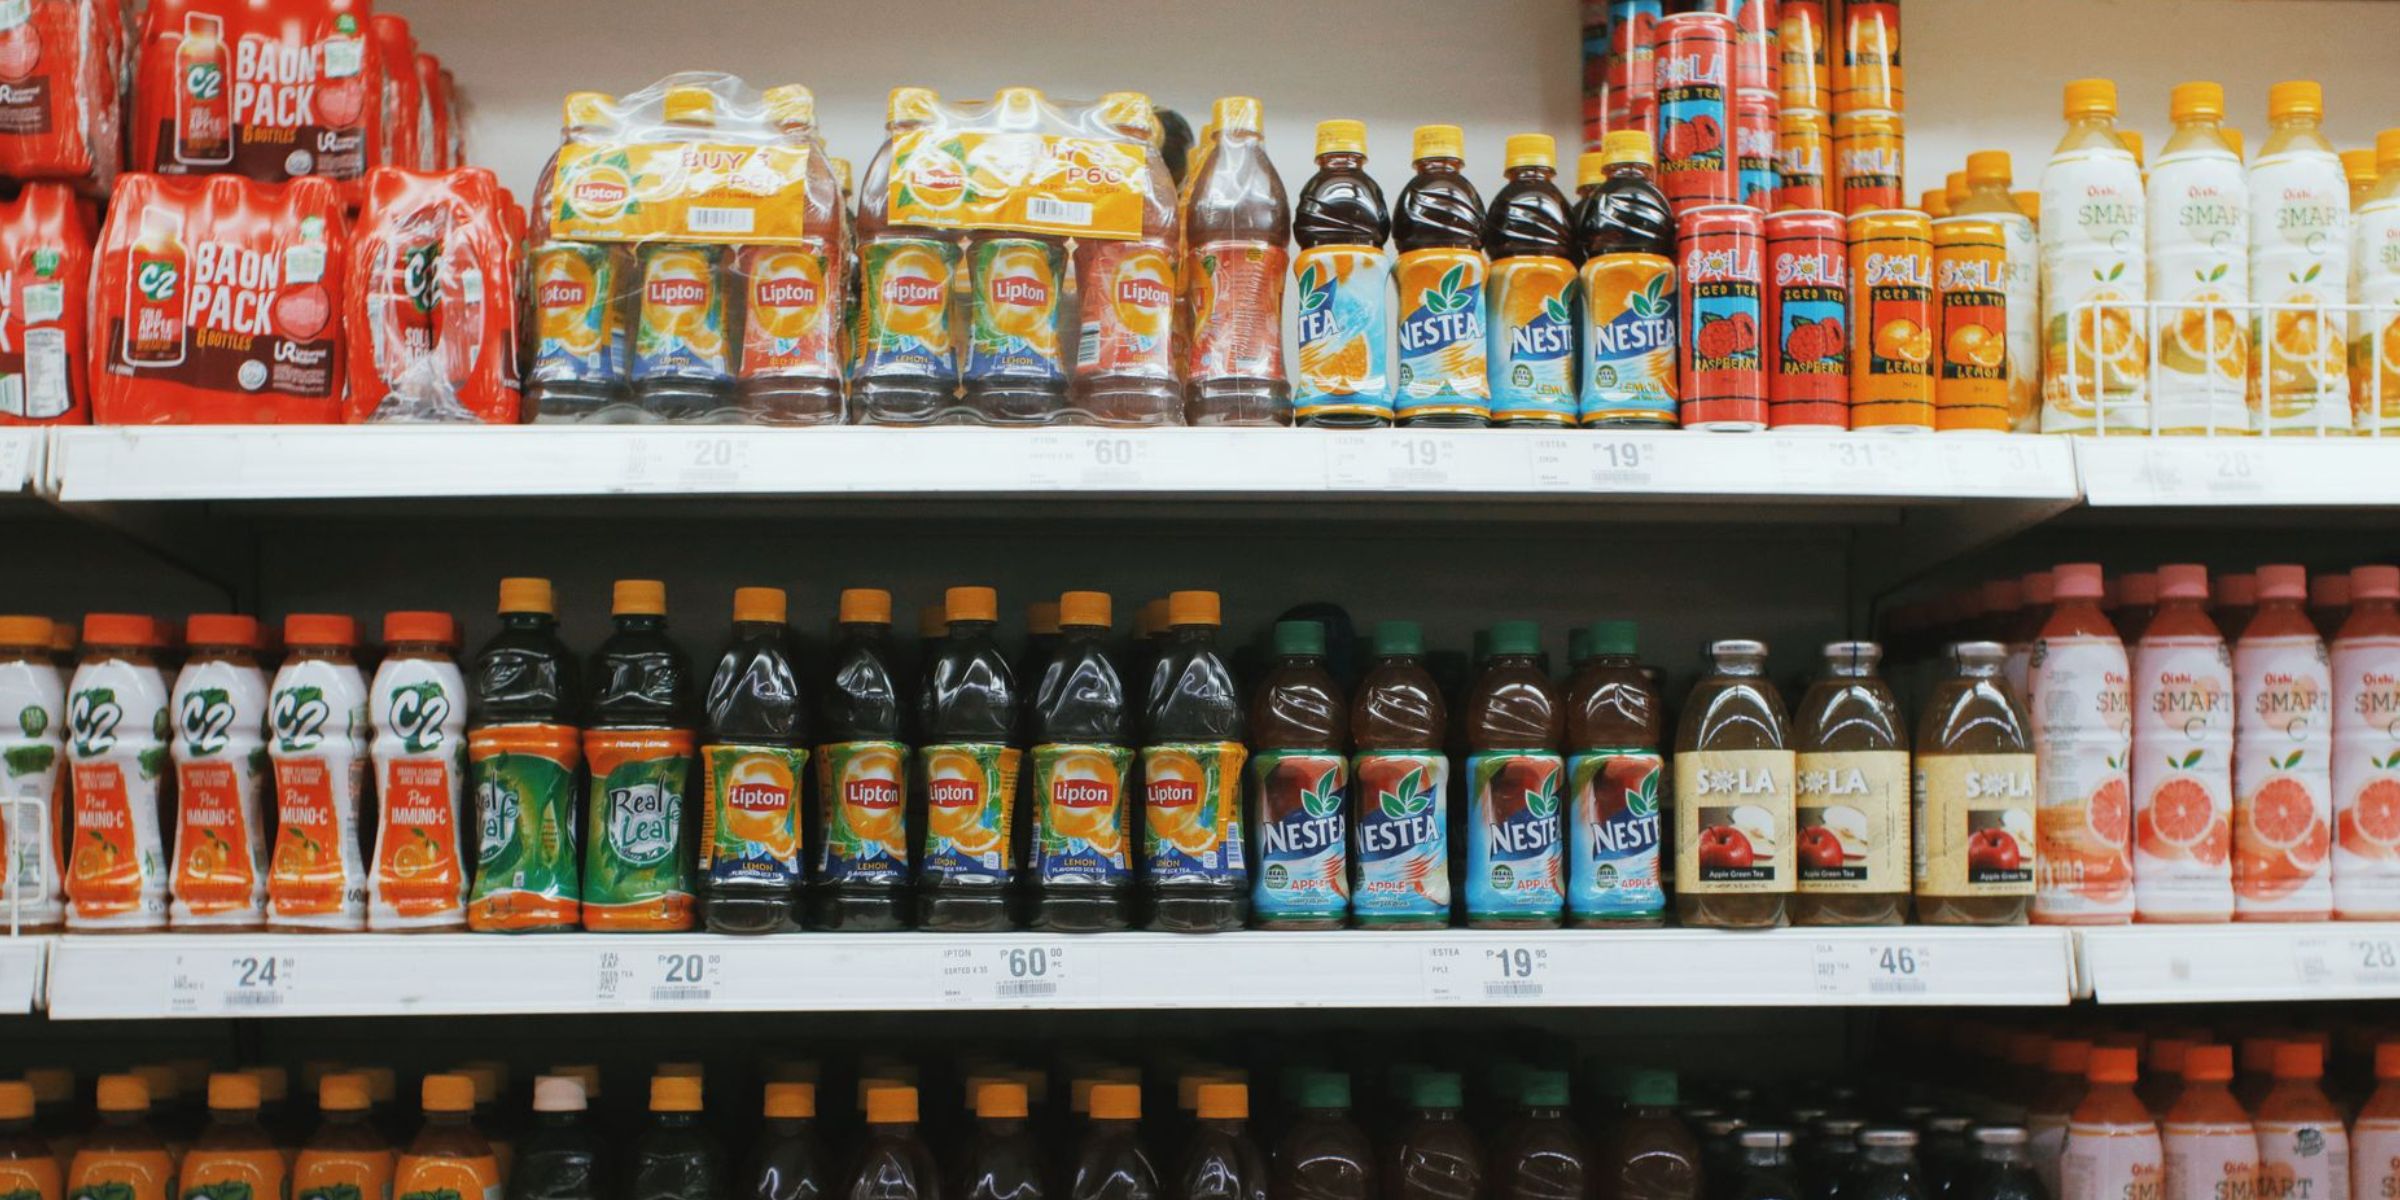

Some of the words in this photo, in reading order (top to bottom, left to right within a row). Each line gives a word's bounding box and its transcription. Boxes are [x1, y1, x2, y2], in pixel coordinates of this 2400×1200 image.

[236, 39, 318, 83] BAON
[187, 66, 222, 98] C2
[233, 82, 317, 128] PACK
[577, 186, 623, 202] Lipton
[195, 240, 283, 291] BAON
[138, 263, 179, 300] C2
[1695, 284, 1729, 297] ICED
[1736, 284, 1759, 297] TEA
[651, 283, 705, 302] Lipton
[760, 285, 814, 303] Lipton
[884, 282, 939, 300] Lipton
[996, 283, 1045, 302] Lipton
[1123, 284, 1170, 303] Lipton
[1783, 289, 1819, 301] ICED
[1825, 289, 1844, 302] TEA
[1873, 288, 1909, 301] ICED
[186, 283, 277, 336] PACK
[1946, 295, 1980, 307] ICED
[196, 326, 207, 348] 6
[207, 329, 253, 352] BOTTLES
[1400, 312, 1483, 351] NESTEA
[1596, 318, 1677, 355] NESTEA
[1001, 357, 1034, 366] LEMON
[1694, 356, 1758, 372] RASPBERRY
[1783, 361, 1845, 376] RASPBERRY
[1886, 360, 1928, 375] LEMON
[1957, 365, 2000, 380] LEMON
[2160, 671, 2192, 685] Oishi
[2264, 672, 2293, 686] Oishi
[2363, 671, 2394, 686] Oishi
[72, 695, 123, 753] C2
[181, 694, 236, 751] C2
[274, 692, 330, 748] C2
[389, 688, 450, 749] C2
[285, 789, 311, 806] Plus
[407, 790, 432, 806] Plus
[610, 771, 667, 823] Real
[731, 786, 786, 808] Lipton
[849, 784, 899, 805] Lipton
[929, 783, 975, 804] Lipton
[1056, 782, 1109, 804] Lipton
[1147, 785, 1193, 805] Lipton
[621, 794, 682, 848] Leaf
[1264, 814, 1346, 854] NESTEA
[1357, 815, 1441, 855] NESTEA
[742, 862, 774, 872] LEMON
[856, 862, 889, 871] LEMON
[1063, 858, 1096, 867] LEMON
[1709, 870, 1730, 879] Apple
[1730, 870, 1752, 878] Green
[1753, 870, 1765, 878] Tea
[1821, 870, 1842, 878] Green
[1843, 870, 1856, 878] Tea
[1980, 872, 2001, 882] Apple
[1368, 881, 1407, 893] APPLE
[1050, 948, 1063, 957] 00
[1535, 949, 1548, 959] 95
